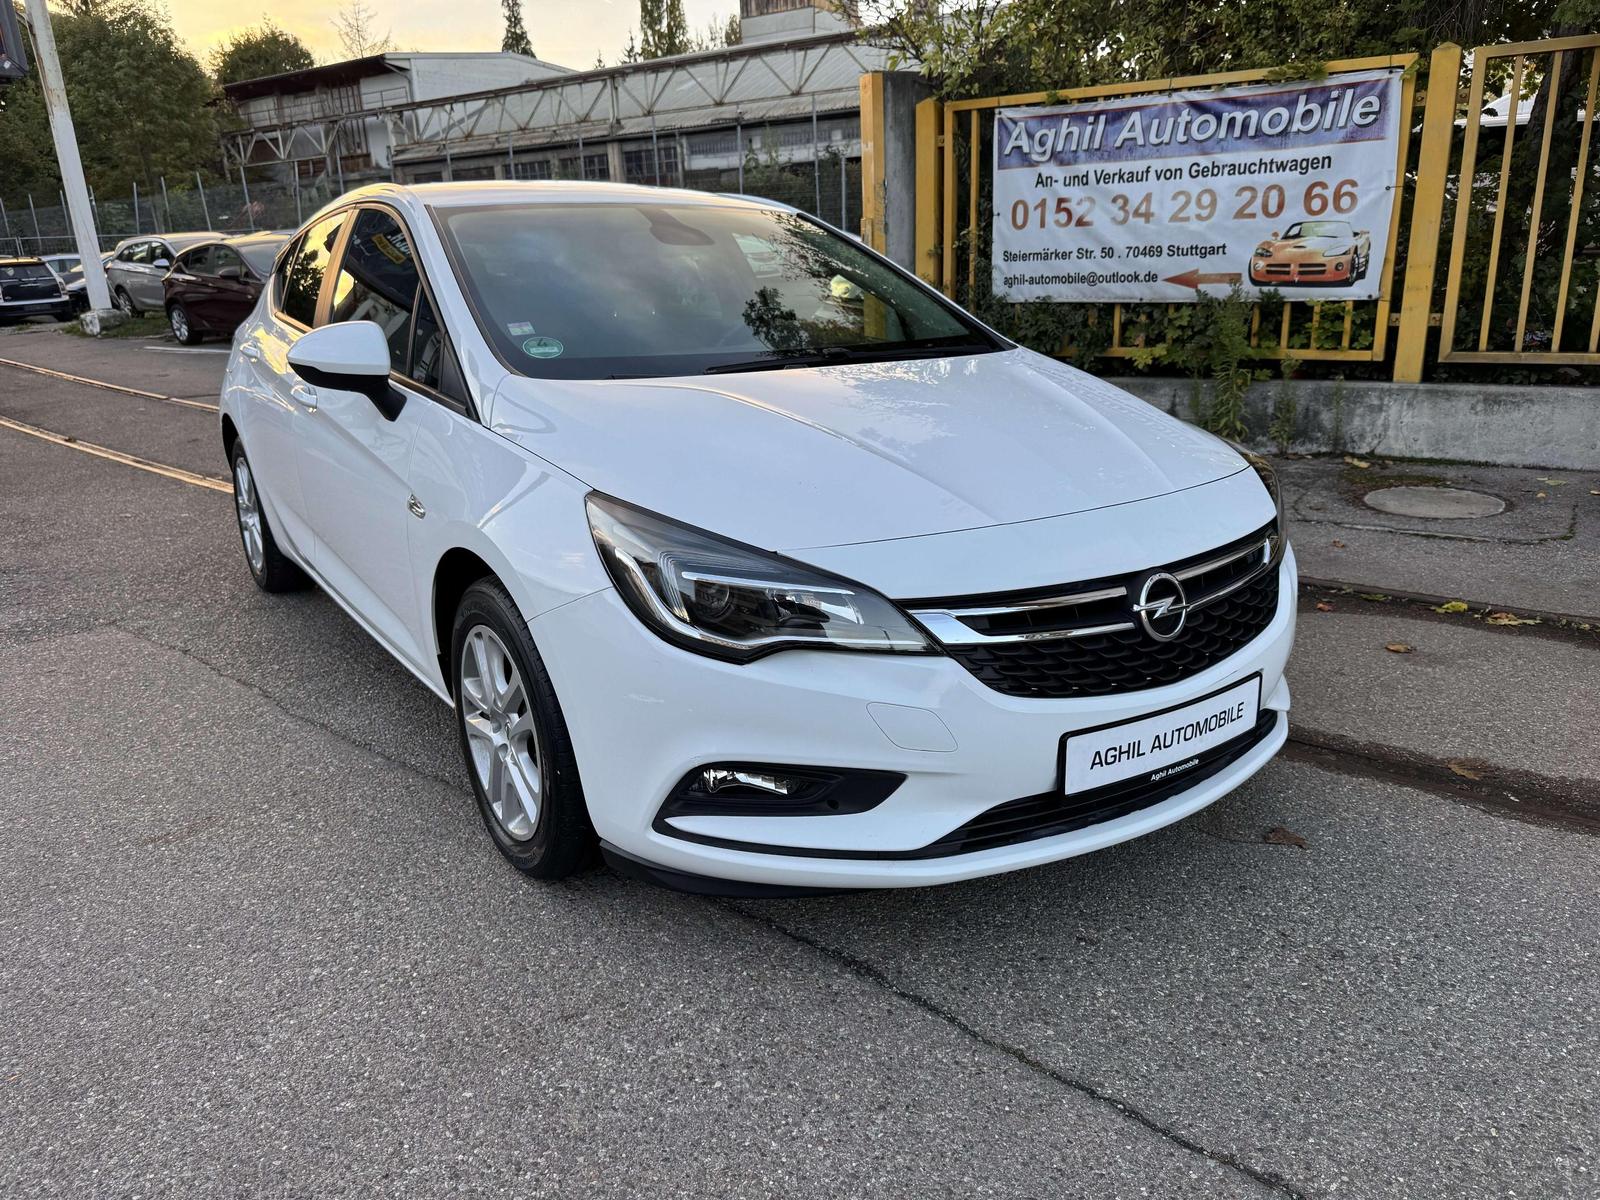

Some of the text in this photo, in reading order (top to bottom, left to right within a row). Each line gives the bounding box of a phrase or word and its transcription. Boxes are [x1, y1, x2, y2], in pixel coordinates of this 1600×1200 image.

[1004, 89, 1381, 164] Aghil Automobile
[1035, 155, 1332, 188] An- und Verkauf von Gebrauchtwagen
[1011, 178, 1359, 231] 0152 34 29 20 66
[1003, 248, 1073, 262] Steiermärker
[1076, 247, 1096, 260] Str.
[1100, 246, 1114, 259] 50
[1125, 245, 1163, 258] 70469
[1166, 243, 1226, 258] Stuttgart
[1003, 271, 1158, 288] aghil-automobile@outlook.de
[1090, 702, 1245, 770] AGHIL AUTOMOBILE
[1150, 758, 1199, 781] Aghil Automobile
